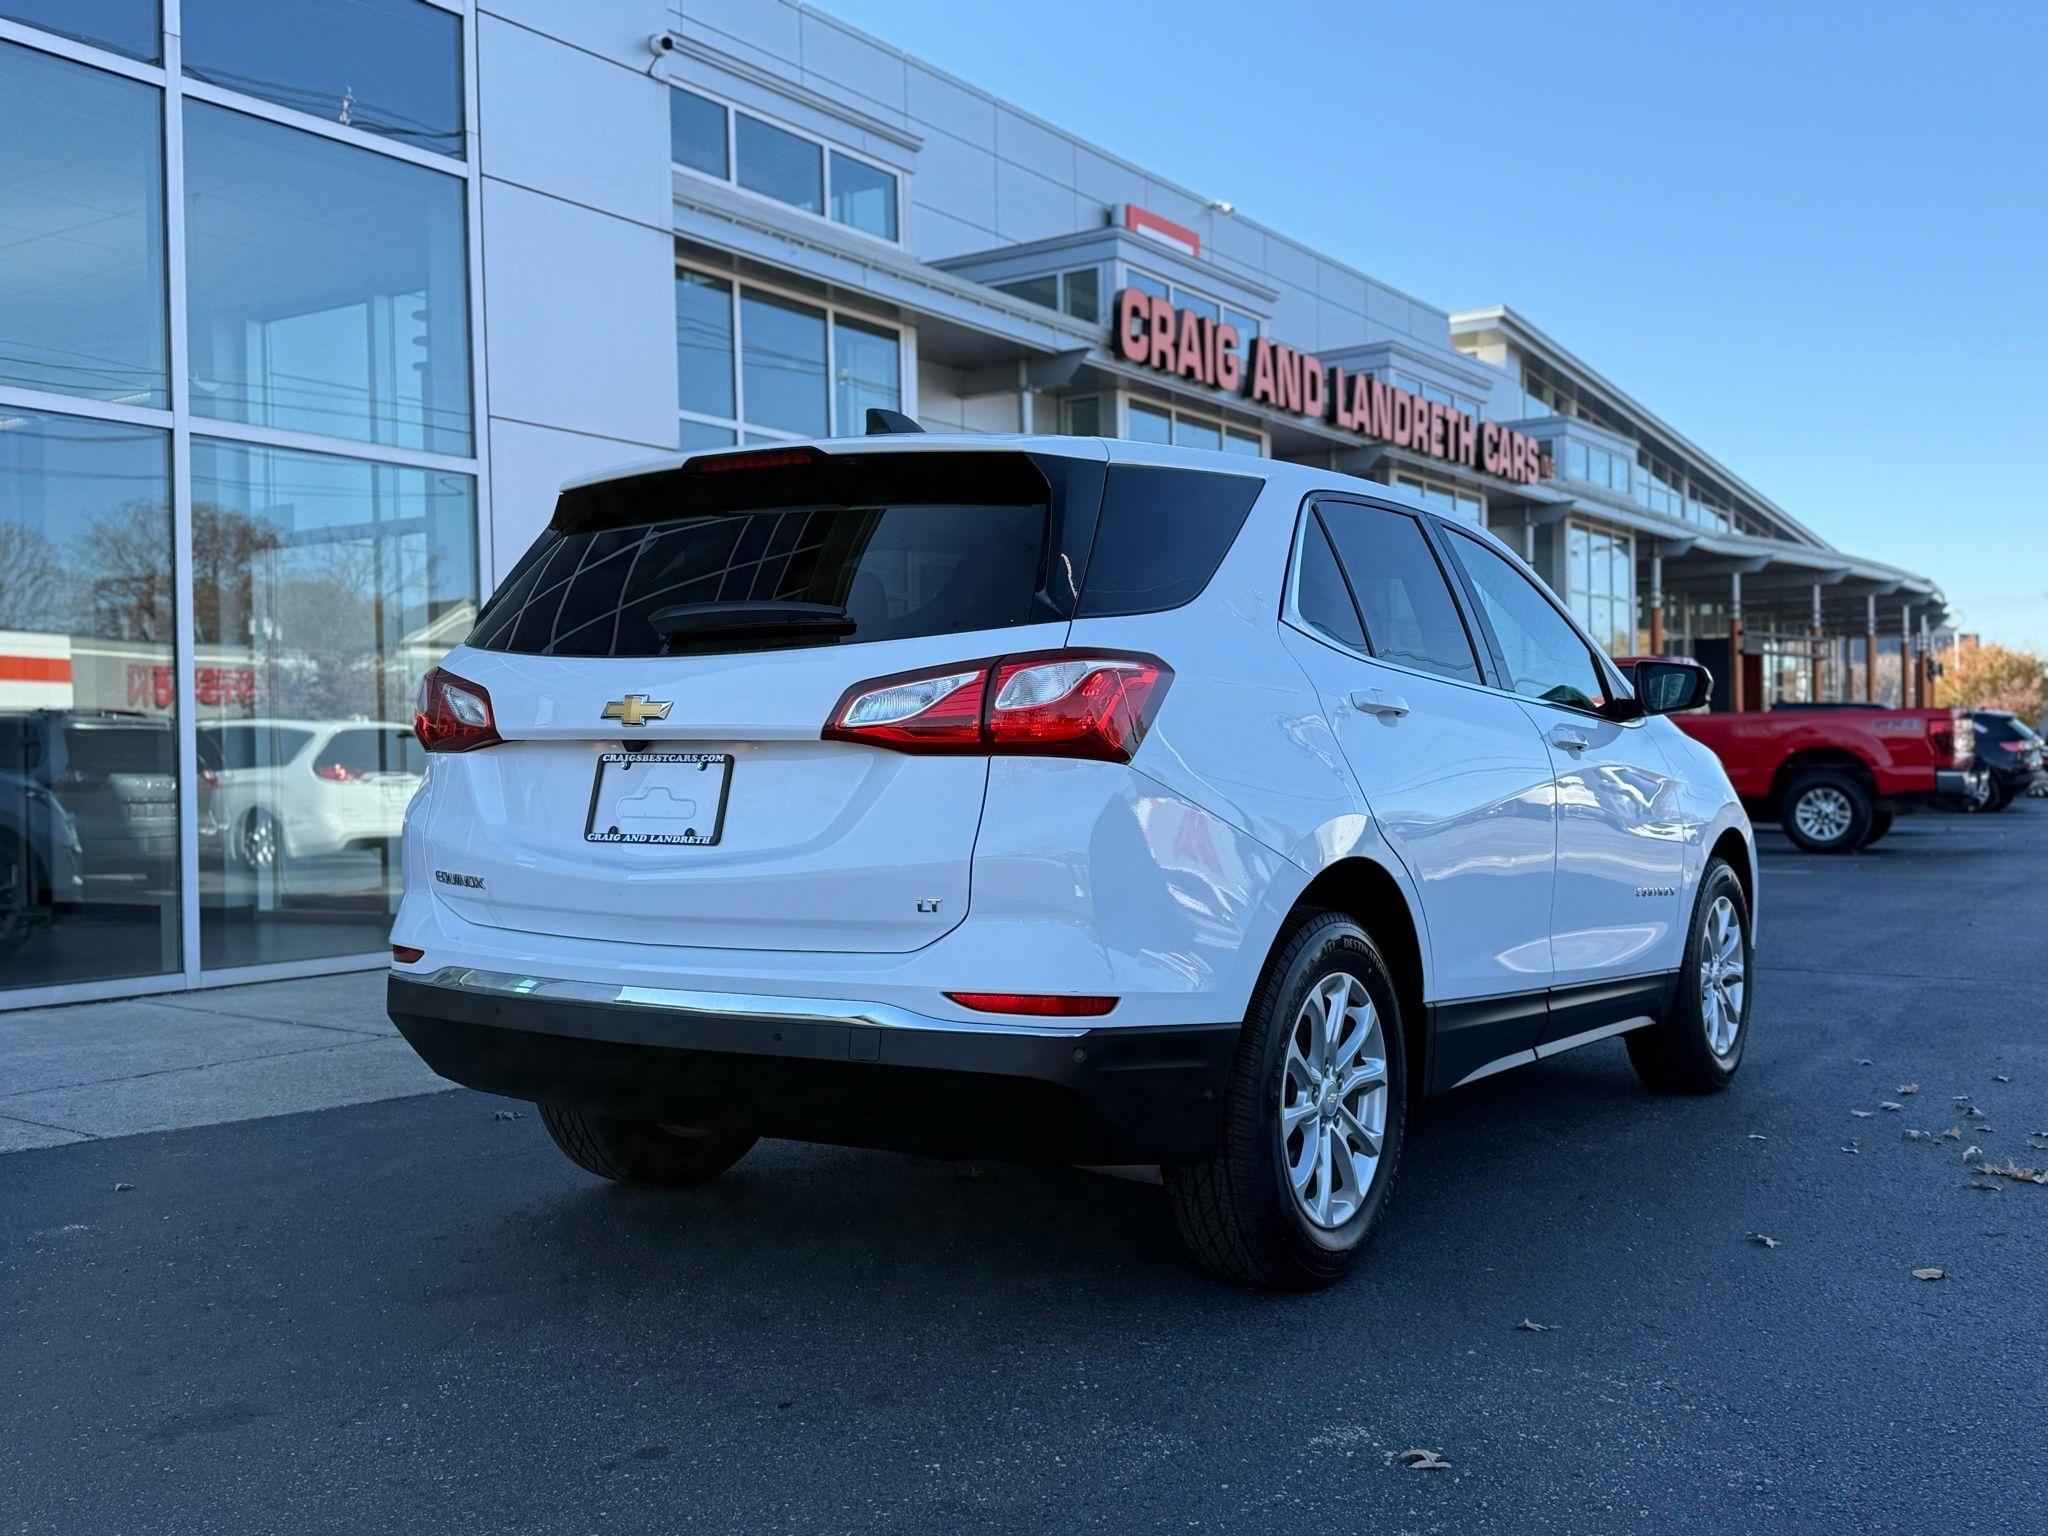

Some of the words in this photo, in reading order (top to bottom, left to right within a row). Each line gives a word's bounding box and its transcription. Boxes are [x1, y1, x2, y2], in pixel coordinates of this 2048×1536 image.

[1119, 287, 1240, 392] CRAIG
[1252, 336, 1325, 418] AND
[1335, 366, 1477, 467] LANDRETH
[1482, 420, 1540, 485] CARS
[602, 754, 726, 763] CRAIGSBESTCARS.COM
[587, 833, 621, 842] CRAIG
[622, 834, 648, 843] AND
[648, 835, 712, 845] LANDRETH
[435, 870, 487, 890] EQUINOX
[917, 898, 942, 913] LT
